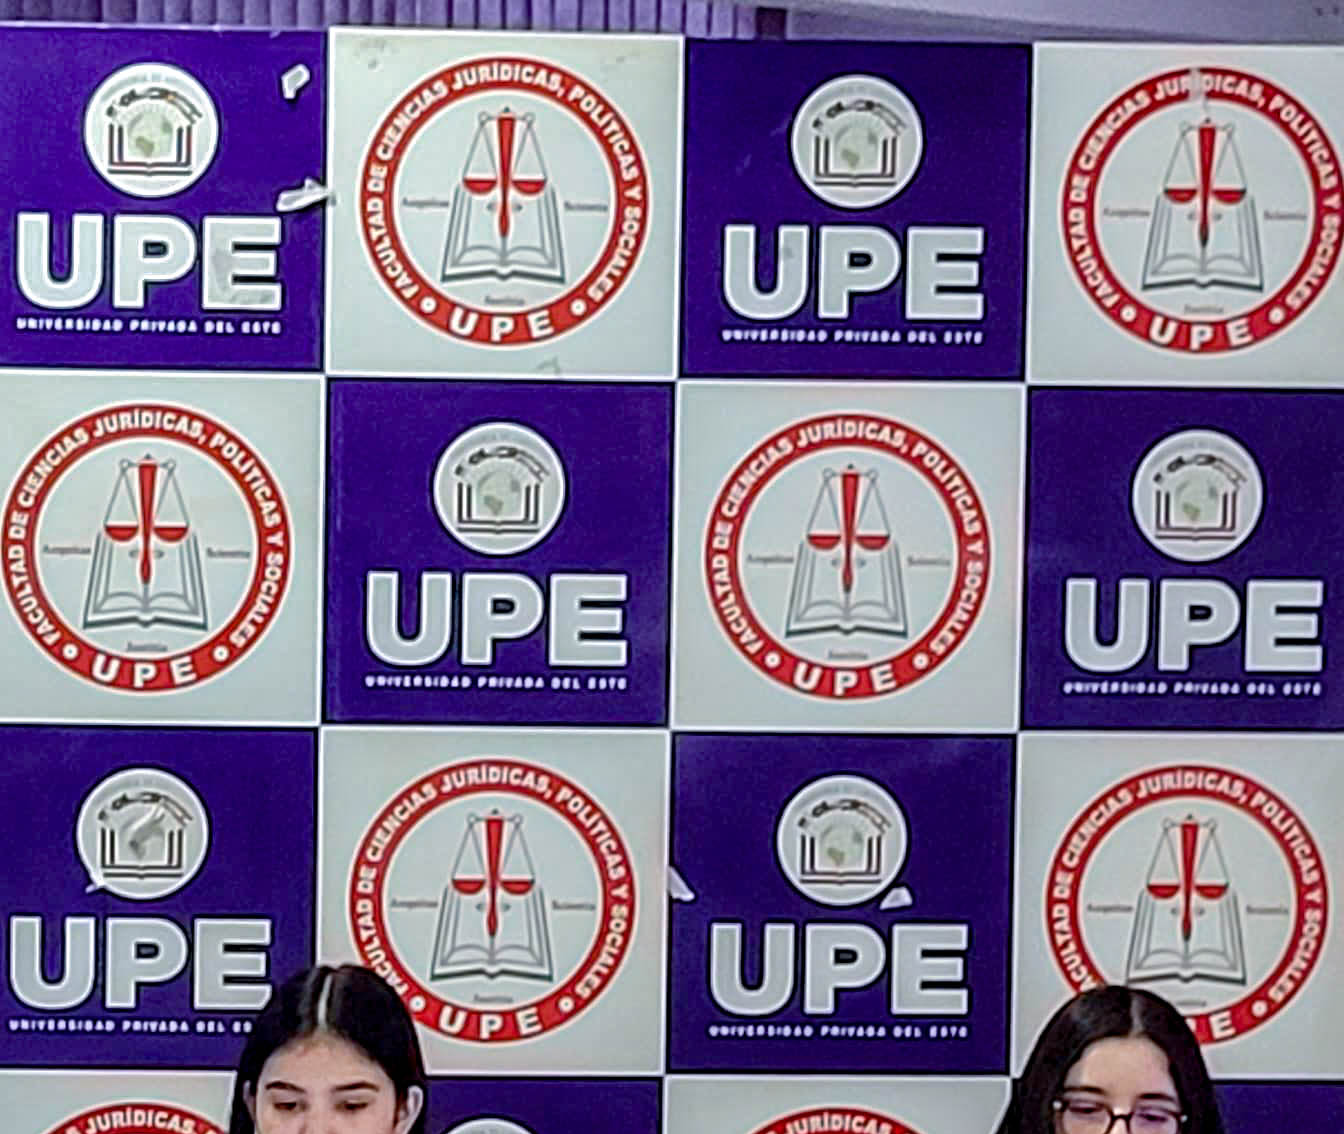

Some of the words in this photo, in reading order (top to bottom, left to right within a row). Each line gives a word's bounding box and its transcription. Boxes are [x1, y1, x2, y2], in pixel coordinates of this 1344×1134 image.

[18, 213, 281, 310] UPE
[725, 226, 983, 319] UPE
[18, 428, 89, 507] CIENCIAS
[210, 432, 281, 527] POLÍTICAS
[9, 511, 29, 539] DE
[267, 532, 283, 546] Y
[8, 546, 60, 644] FACULTAD
[230, 552, 283, 647] SOCIALES
[367, 572, 626, 665] UPE
[1066, 579, 1322, 670] UPE
[93, 654, 196, 687] UPE
[11, 917, 271, 1009] UPE
[711, 924, 967, 1014] UPE
